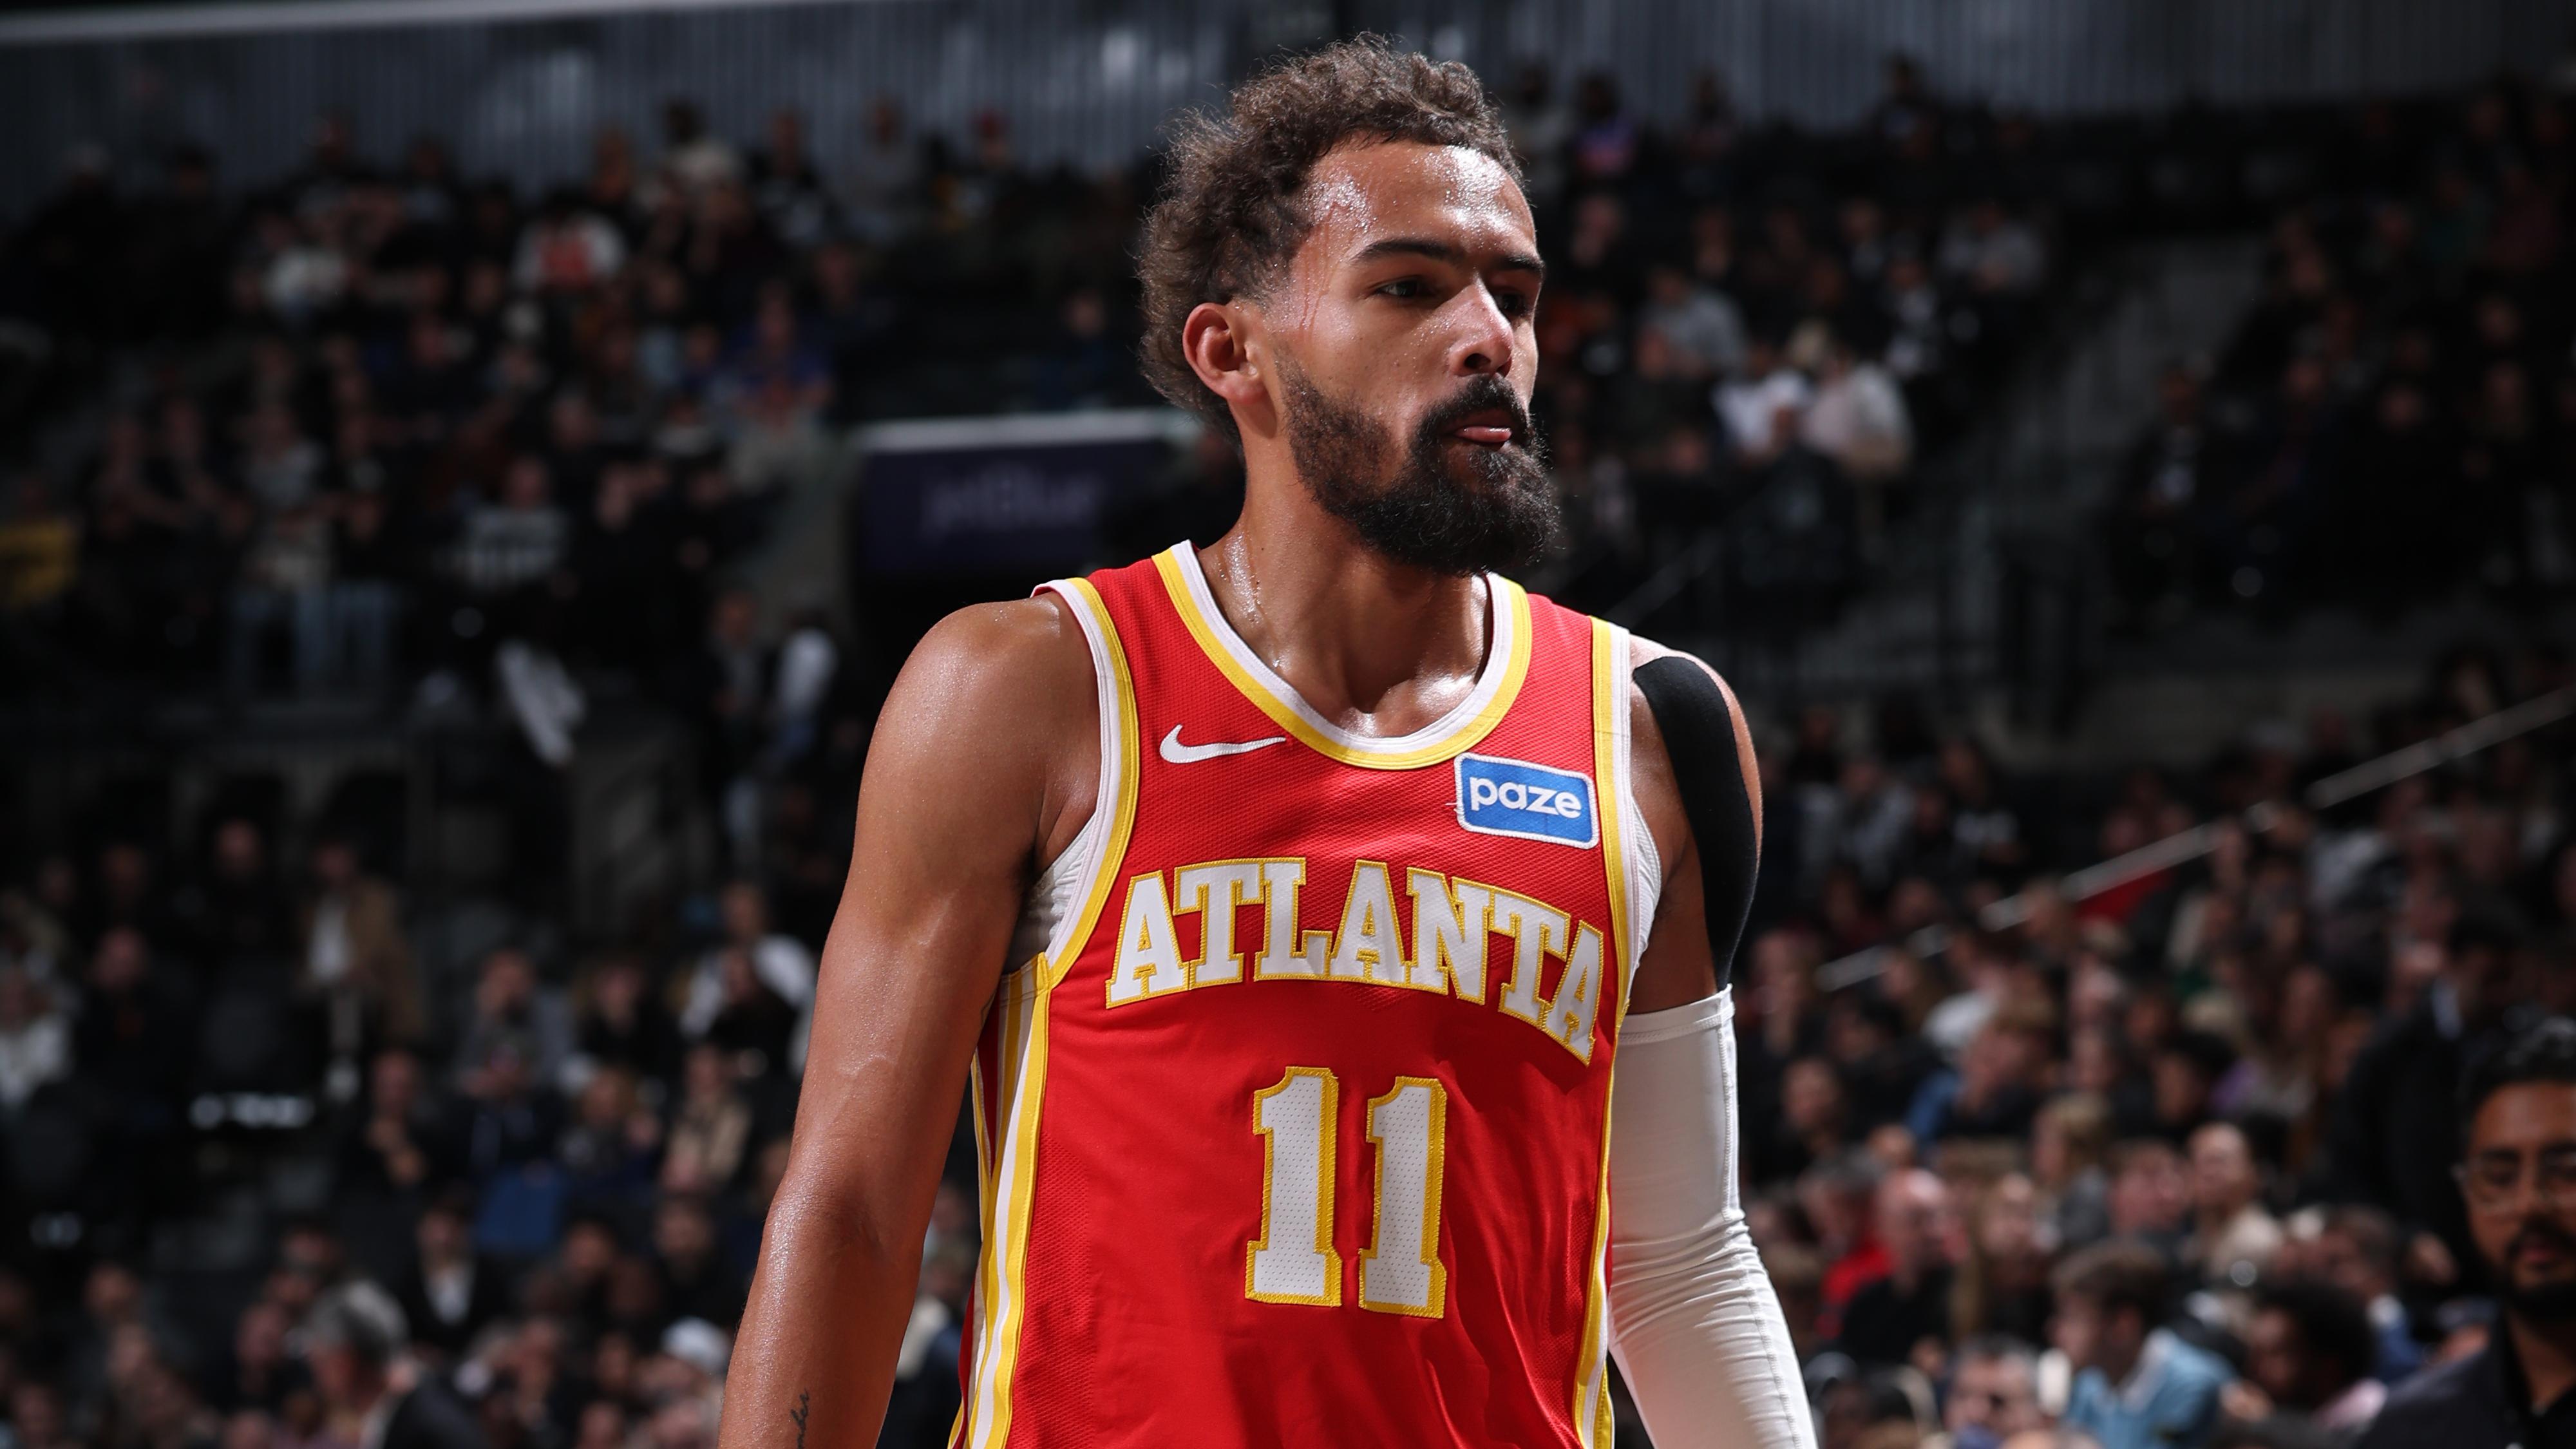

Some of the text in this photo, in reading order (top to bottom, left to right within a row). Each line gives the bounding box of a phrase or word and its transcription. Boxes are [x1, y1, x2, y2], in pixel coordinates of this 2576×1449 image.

[1469, 777, 1582, 819] paze
[1106, 857, 1604, 1066] ATLANTA
[1245, 1066, 1446, 1319] 11
